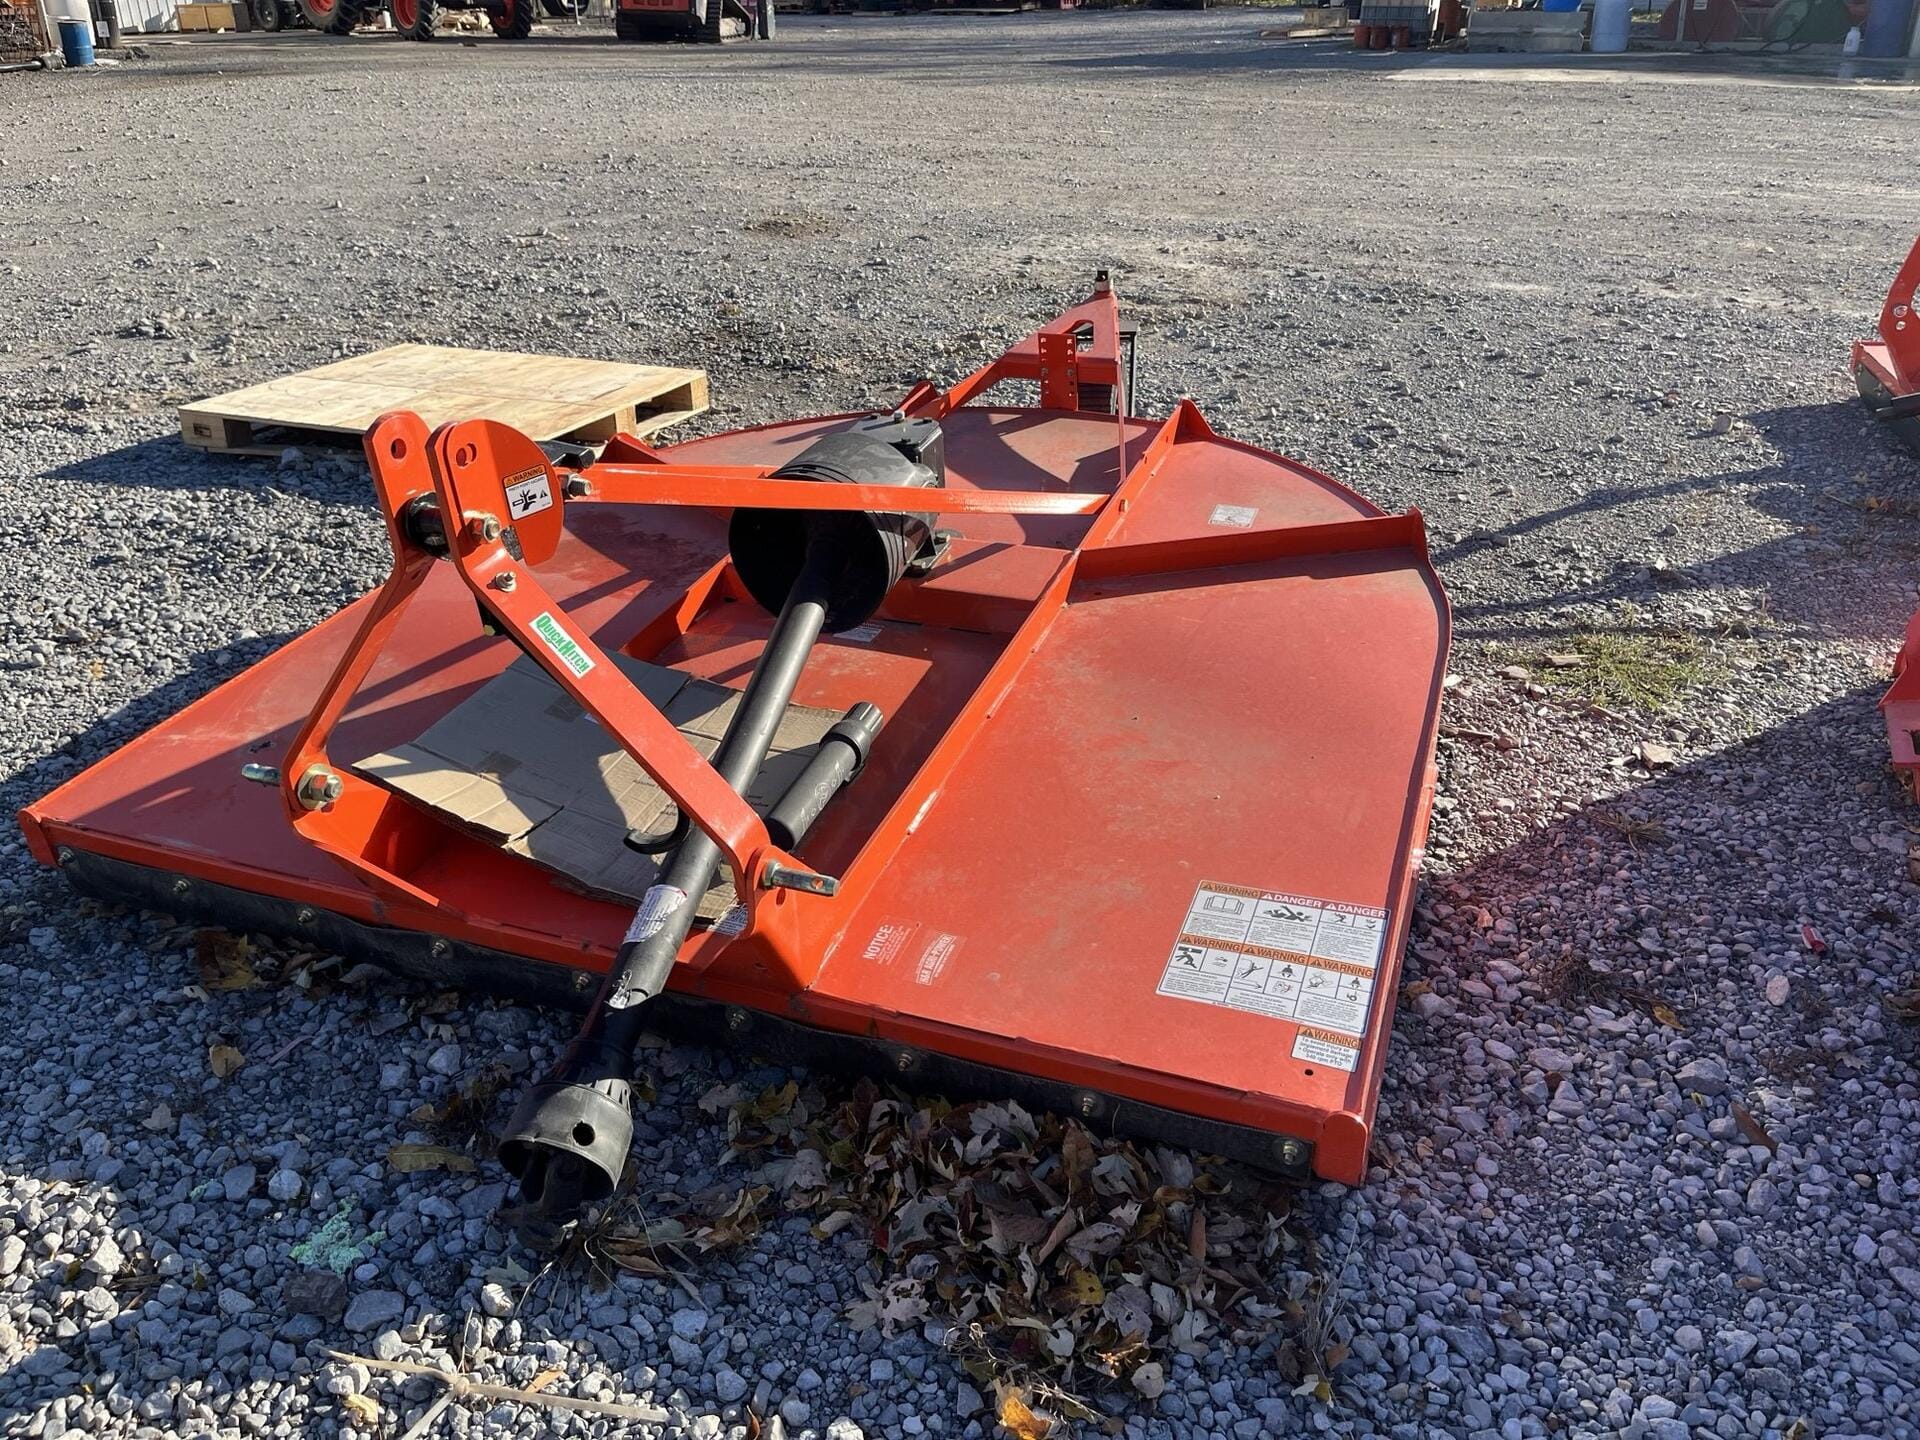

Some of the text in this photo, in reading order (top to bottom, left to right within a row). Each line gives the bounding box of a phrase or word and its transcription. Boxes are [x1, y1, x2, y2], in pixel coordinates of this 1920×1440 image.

[513, 467, 543, 483] WARNING
[1214, 885, 1258, 897] WARNING
[1273, 894, 1322, 908] DANGER
[1337, 903, 1386, 918] DANGER
[862, 924, 894, 960] NOTICE:
[1193, 937, 1241, 951] WARNING
[1257, 948, 1306, 964] WARNING
[1323, 962, 1373, 977] WARNING
[1314, 1029, 1358, 1047] WARNING
